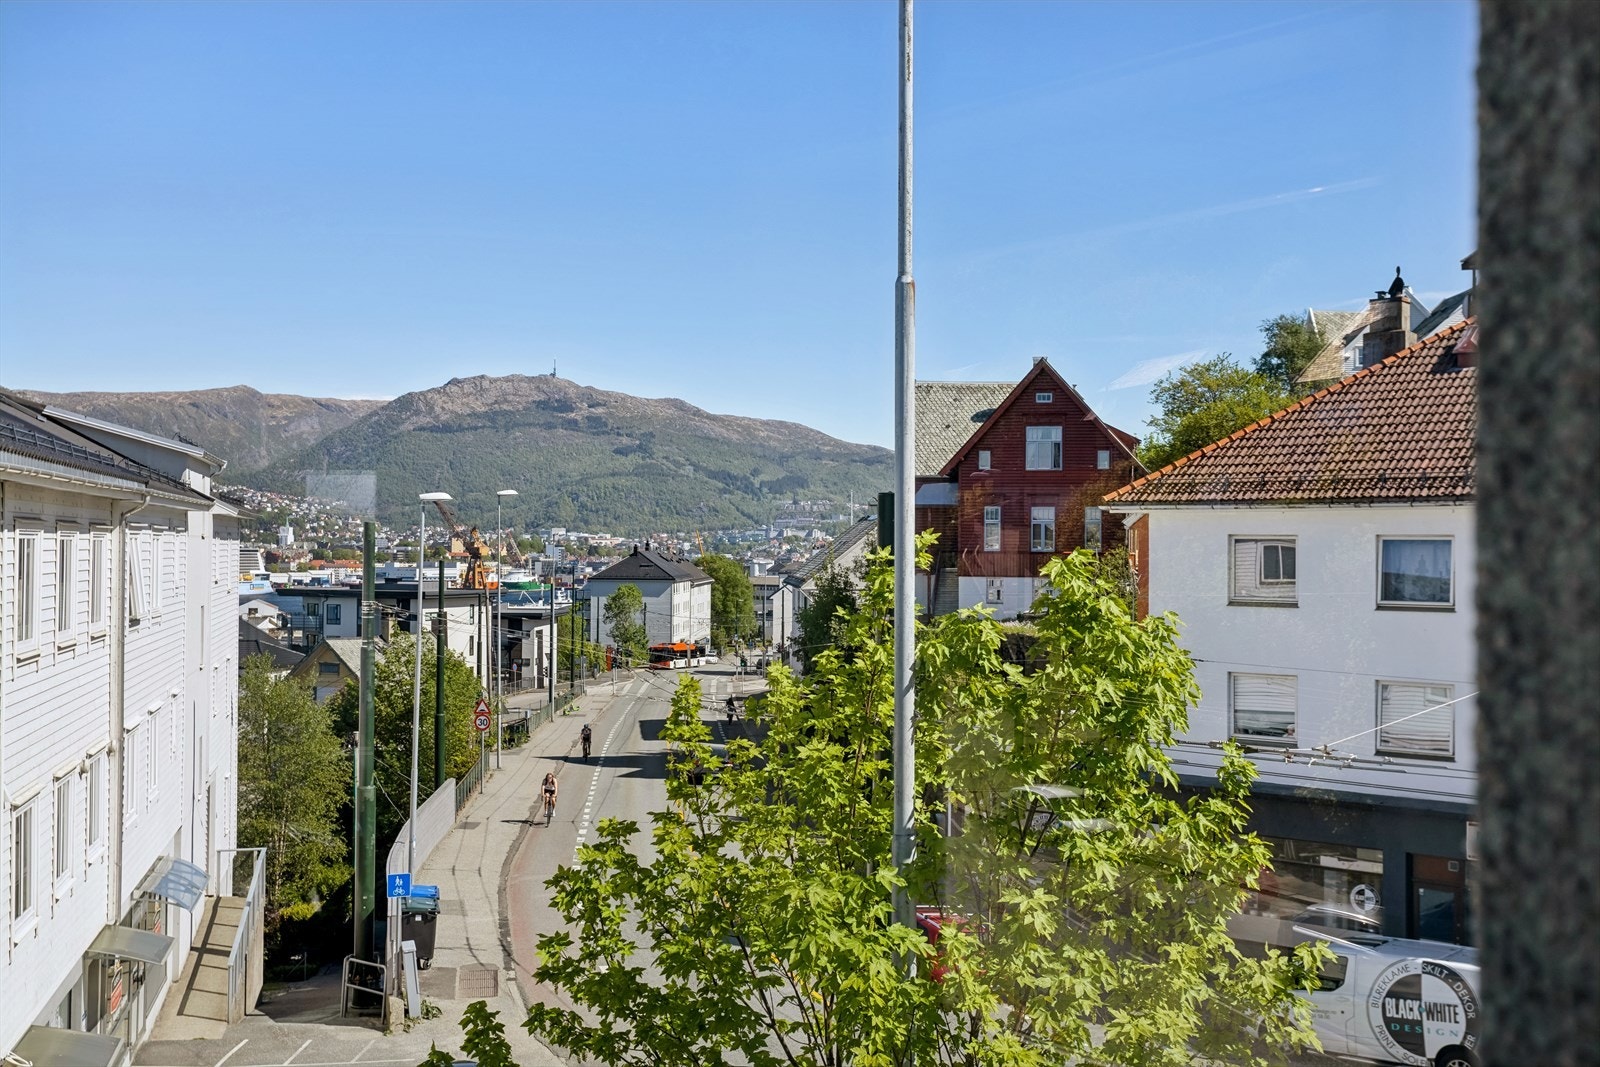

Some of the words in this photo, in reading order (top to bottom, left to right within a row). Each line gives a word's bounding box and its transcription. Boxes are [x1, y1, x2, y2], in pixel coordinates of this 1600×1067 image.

[478, 719, 488, 727] 30
[1371, 964, 1411, 1009] BILREKLAME
[1422, 963, 1449, 979] SKILT
[1453, 982, 1476, 1019] DEKOR
[1385, 998, 1421, 1020] BLACK
[1425, 1002, 1460, 1024] WHITE
[1376, 1024, 1396, 1049] PRINT
[1391, 1023, 1459, 1038] DESIGN
